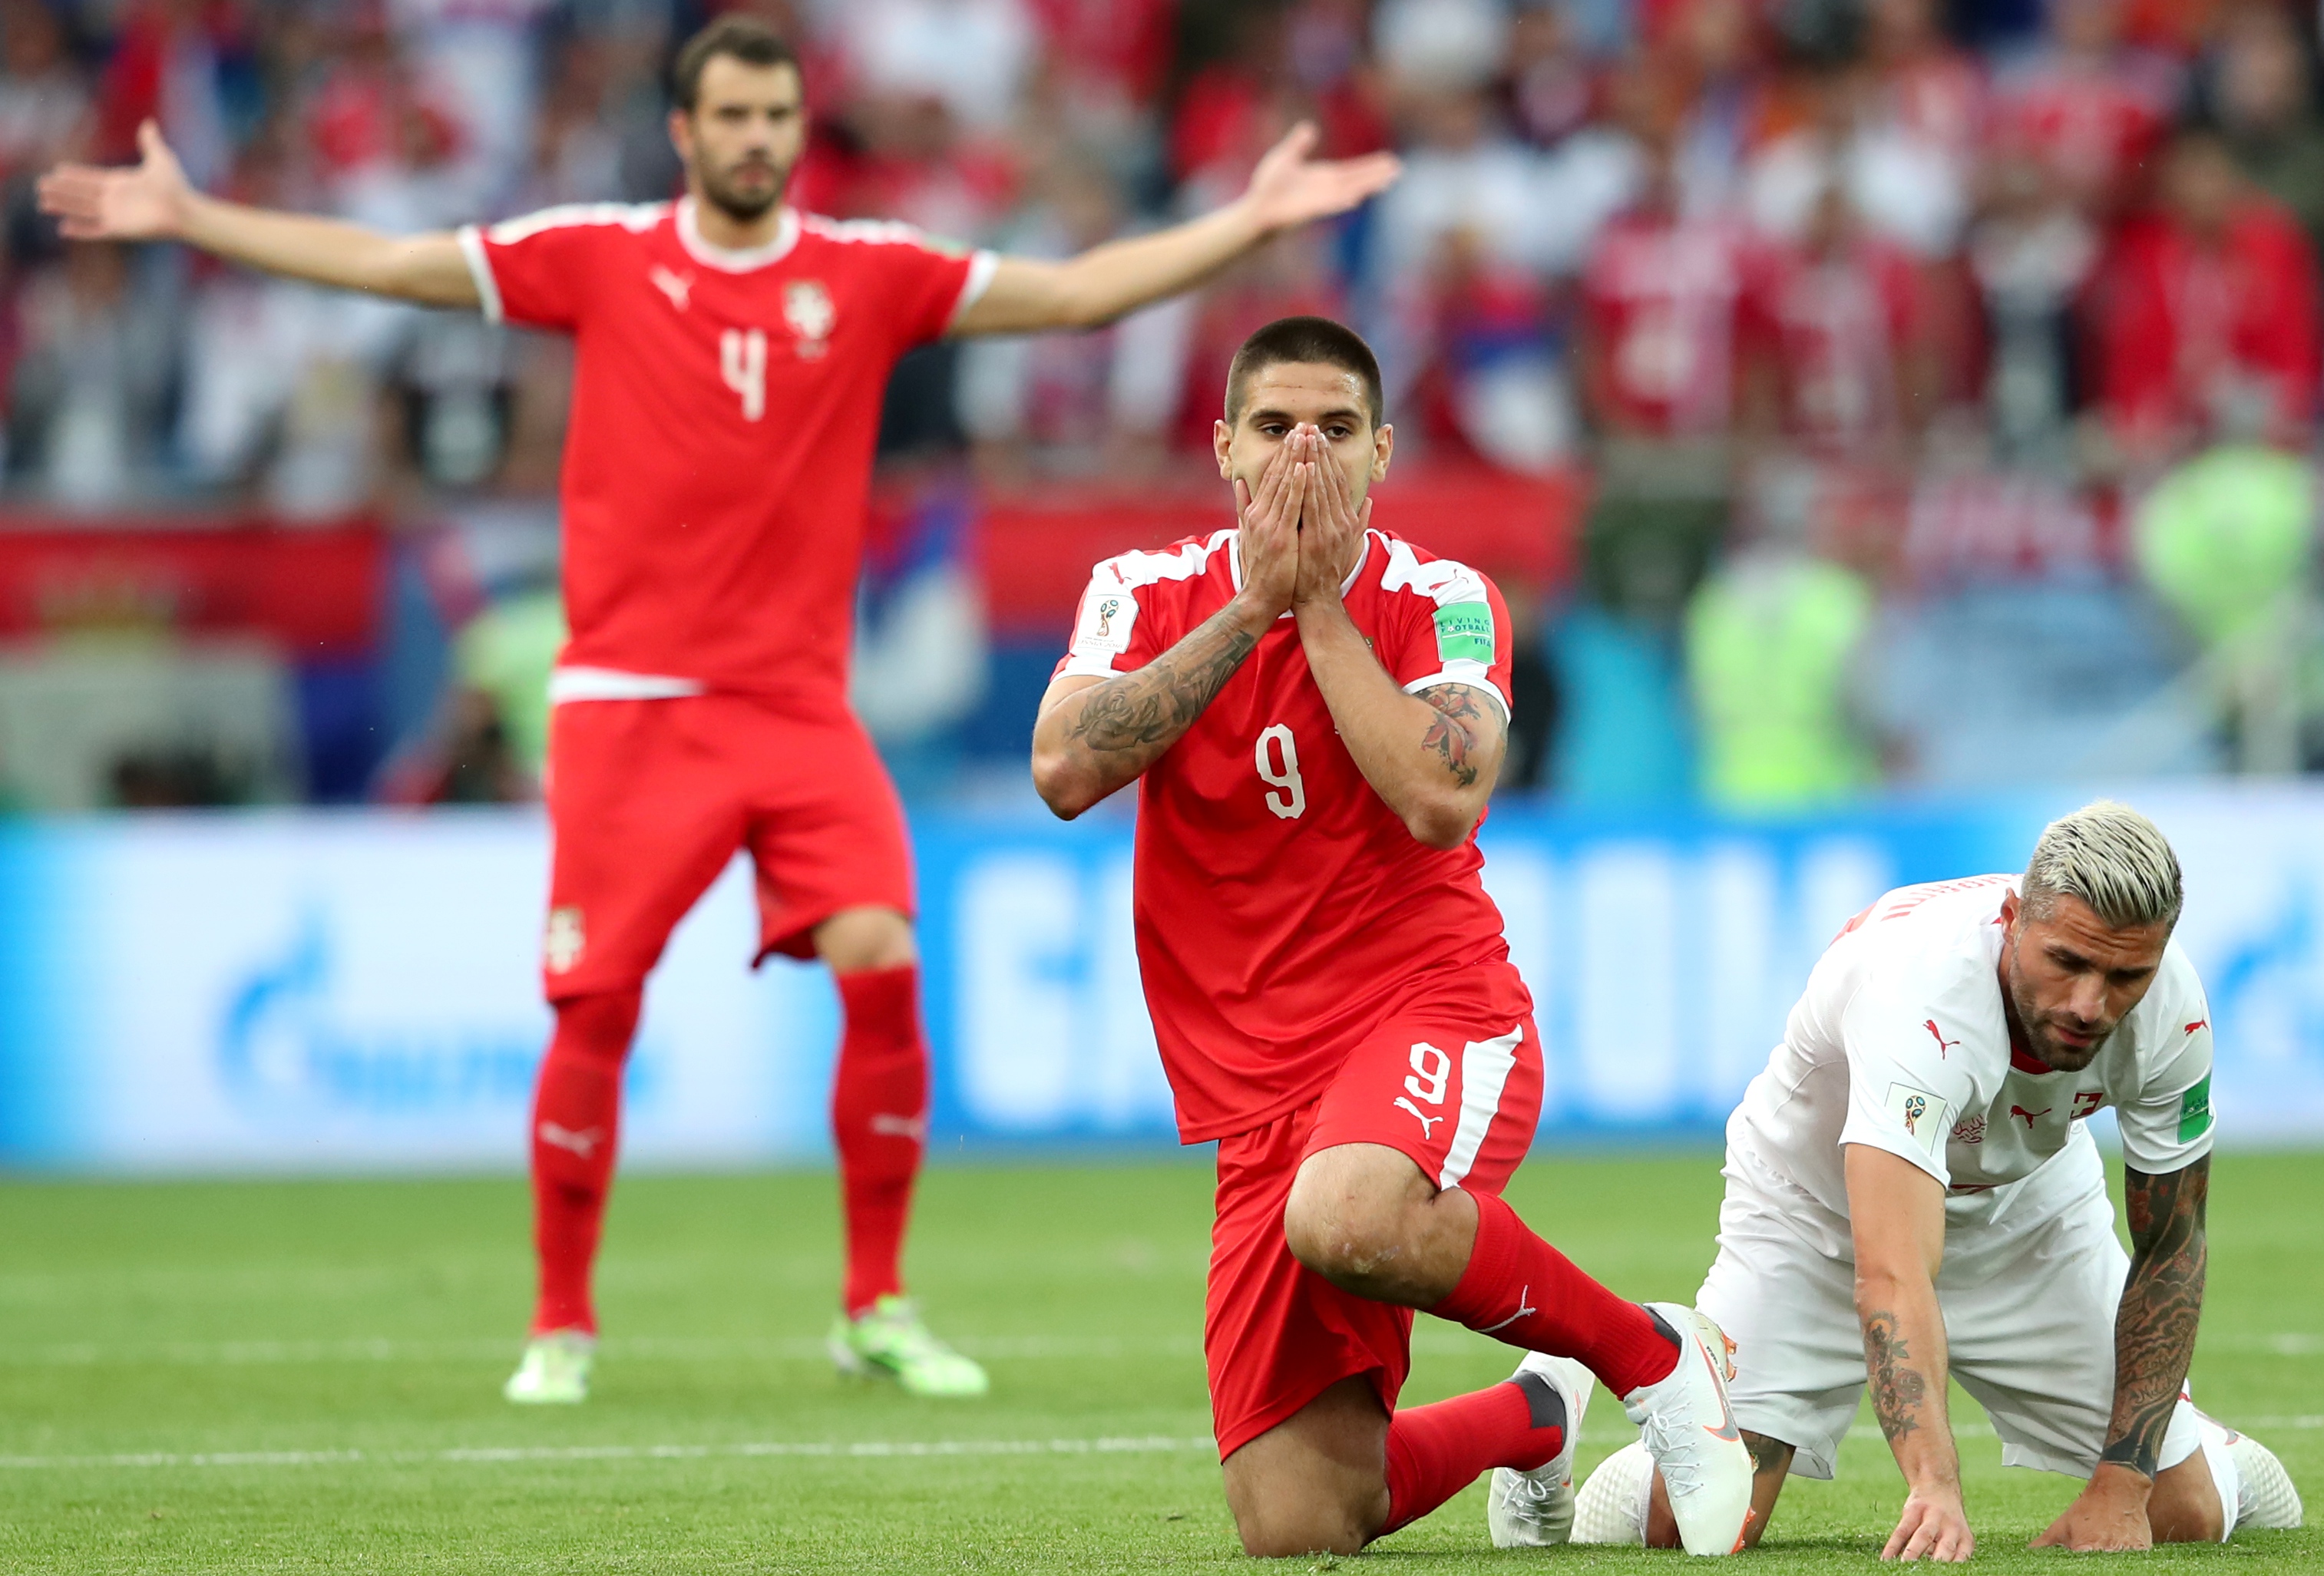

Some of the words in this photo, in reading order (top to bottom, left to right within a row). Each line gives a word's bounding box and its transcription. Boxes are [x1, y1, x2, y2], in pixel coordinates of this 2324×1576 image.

[719, 329, 767, 421] 4
[1440, 617, 1490, 627] LIVING
[1441, 624, 1490, 633] FOOTBALL
[1474, 638, 1491, 648] FIFA
[1255, 723, 1305, 819] 9
[1403, 1042, 1452, 1105] 9
